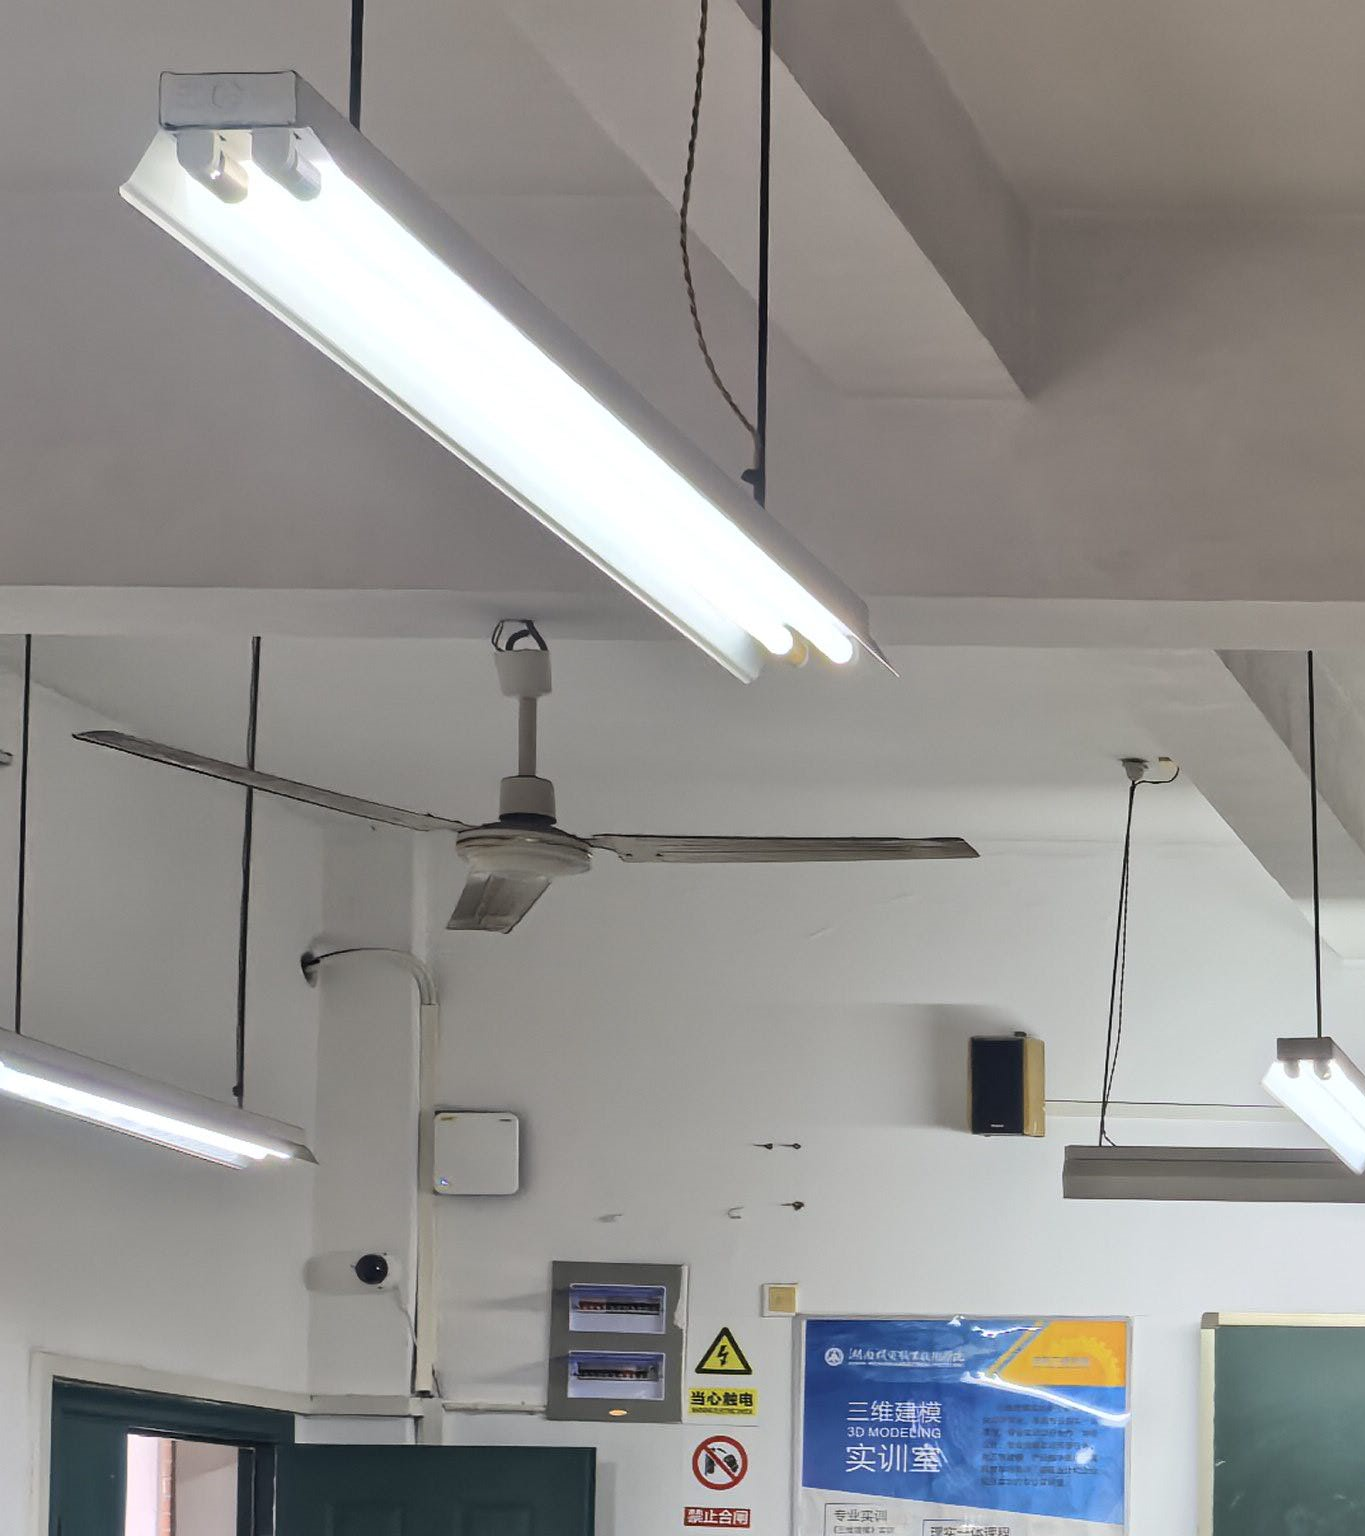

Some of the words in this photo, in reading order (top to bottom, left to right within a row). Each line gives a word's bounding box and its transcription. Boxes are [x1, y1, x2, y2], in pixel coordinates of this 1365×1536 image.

[690, 1391, 754, 1407] 当心触电
[846, 1401, 943, 1424] 三维建模
[847, 1427, 865, 1438] 3D
[868, 1427, 942, 1440] MODELING
[845, 1443, 942, 1474] 实训室
[687, 1508, 749, 1525] 禁止合闸
[833, 1509, 888, 1523] 专业实训
